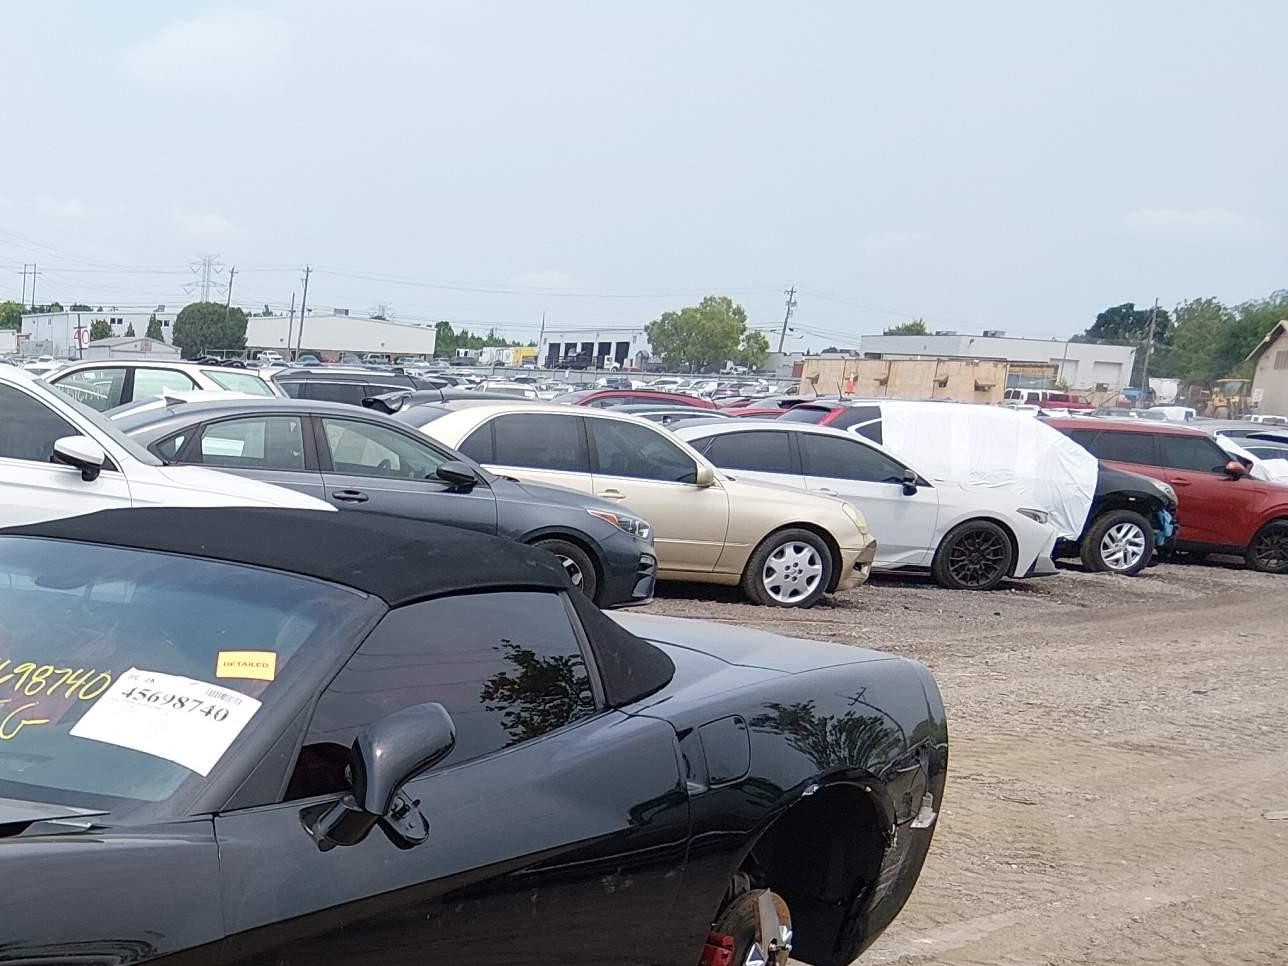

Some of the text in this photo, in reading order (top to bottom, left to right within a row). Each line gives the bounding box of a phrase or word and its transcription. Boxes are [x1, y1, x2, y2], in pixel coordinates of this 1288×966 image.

[74, 329, 90, 345] 40
[223, 661, 269, 669] DETAILED
[121, 686, 230, 722] 45698740
